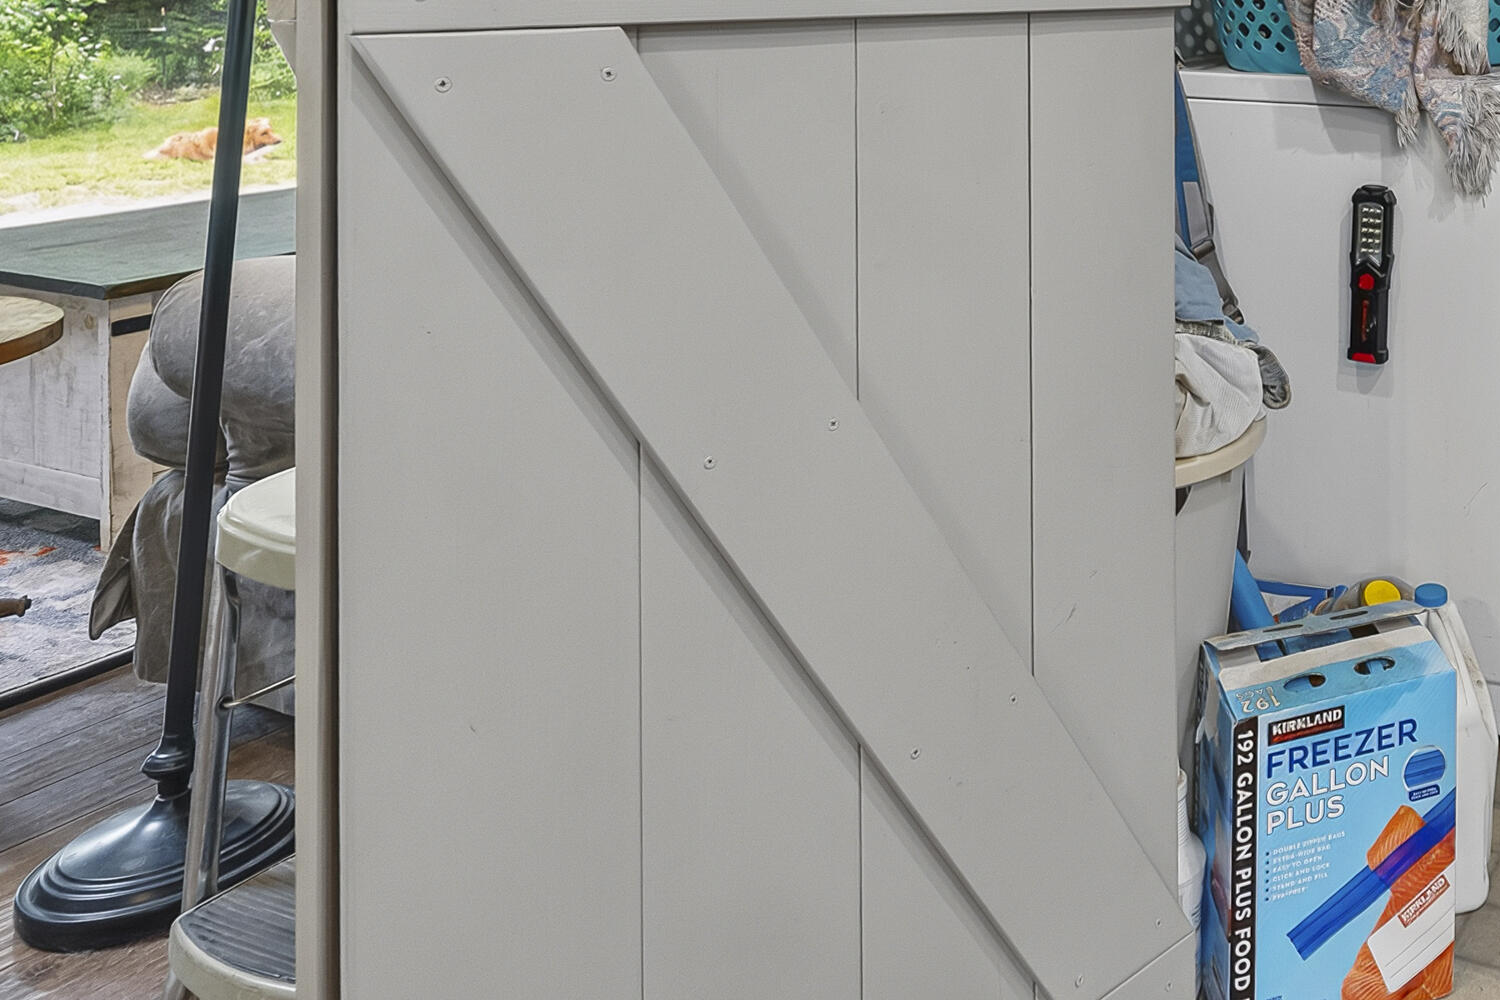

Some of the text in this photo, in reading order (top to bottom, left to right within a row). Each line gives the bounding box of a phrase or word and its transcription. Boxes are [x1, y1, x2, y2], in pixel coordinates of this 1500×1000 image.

[1271, 708, 1343, 736] KIRKLAND
[1266, 718, 1418, 779] FREEZER
[1266, 755, 1390, 807] GALLON
[1266, 795, 1345, 836] PLUS
[1234, 729, 1254, 992] 192 GALLON PLUS FOOD
[1273, 841, 1301, 856] DOUBLE
[1303, 855, 1323, 865] OPEN
[1401, 877, 1447, 922] KIRKLAND
